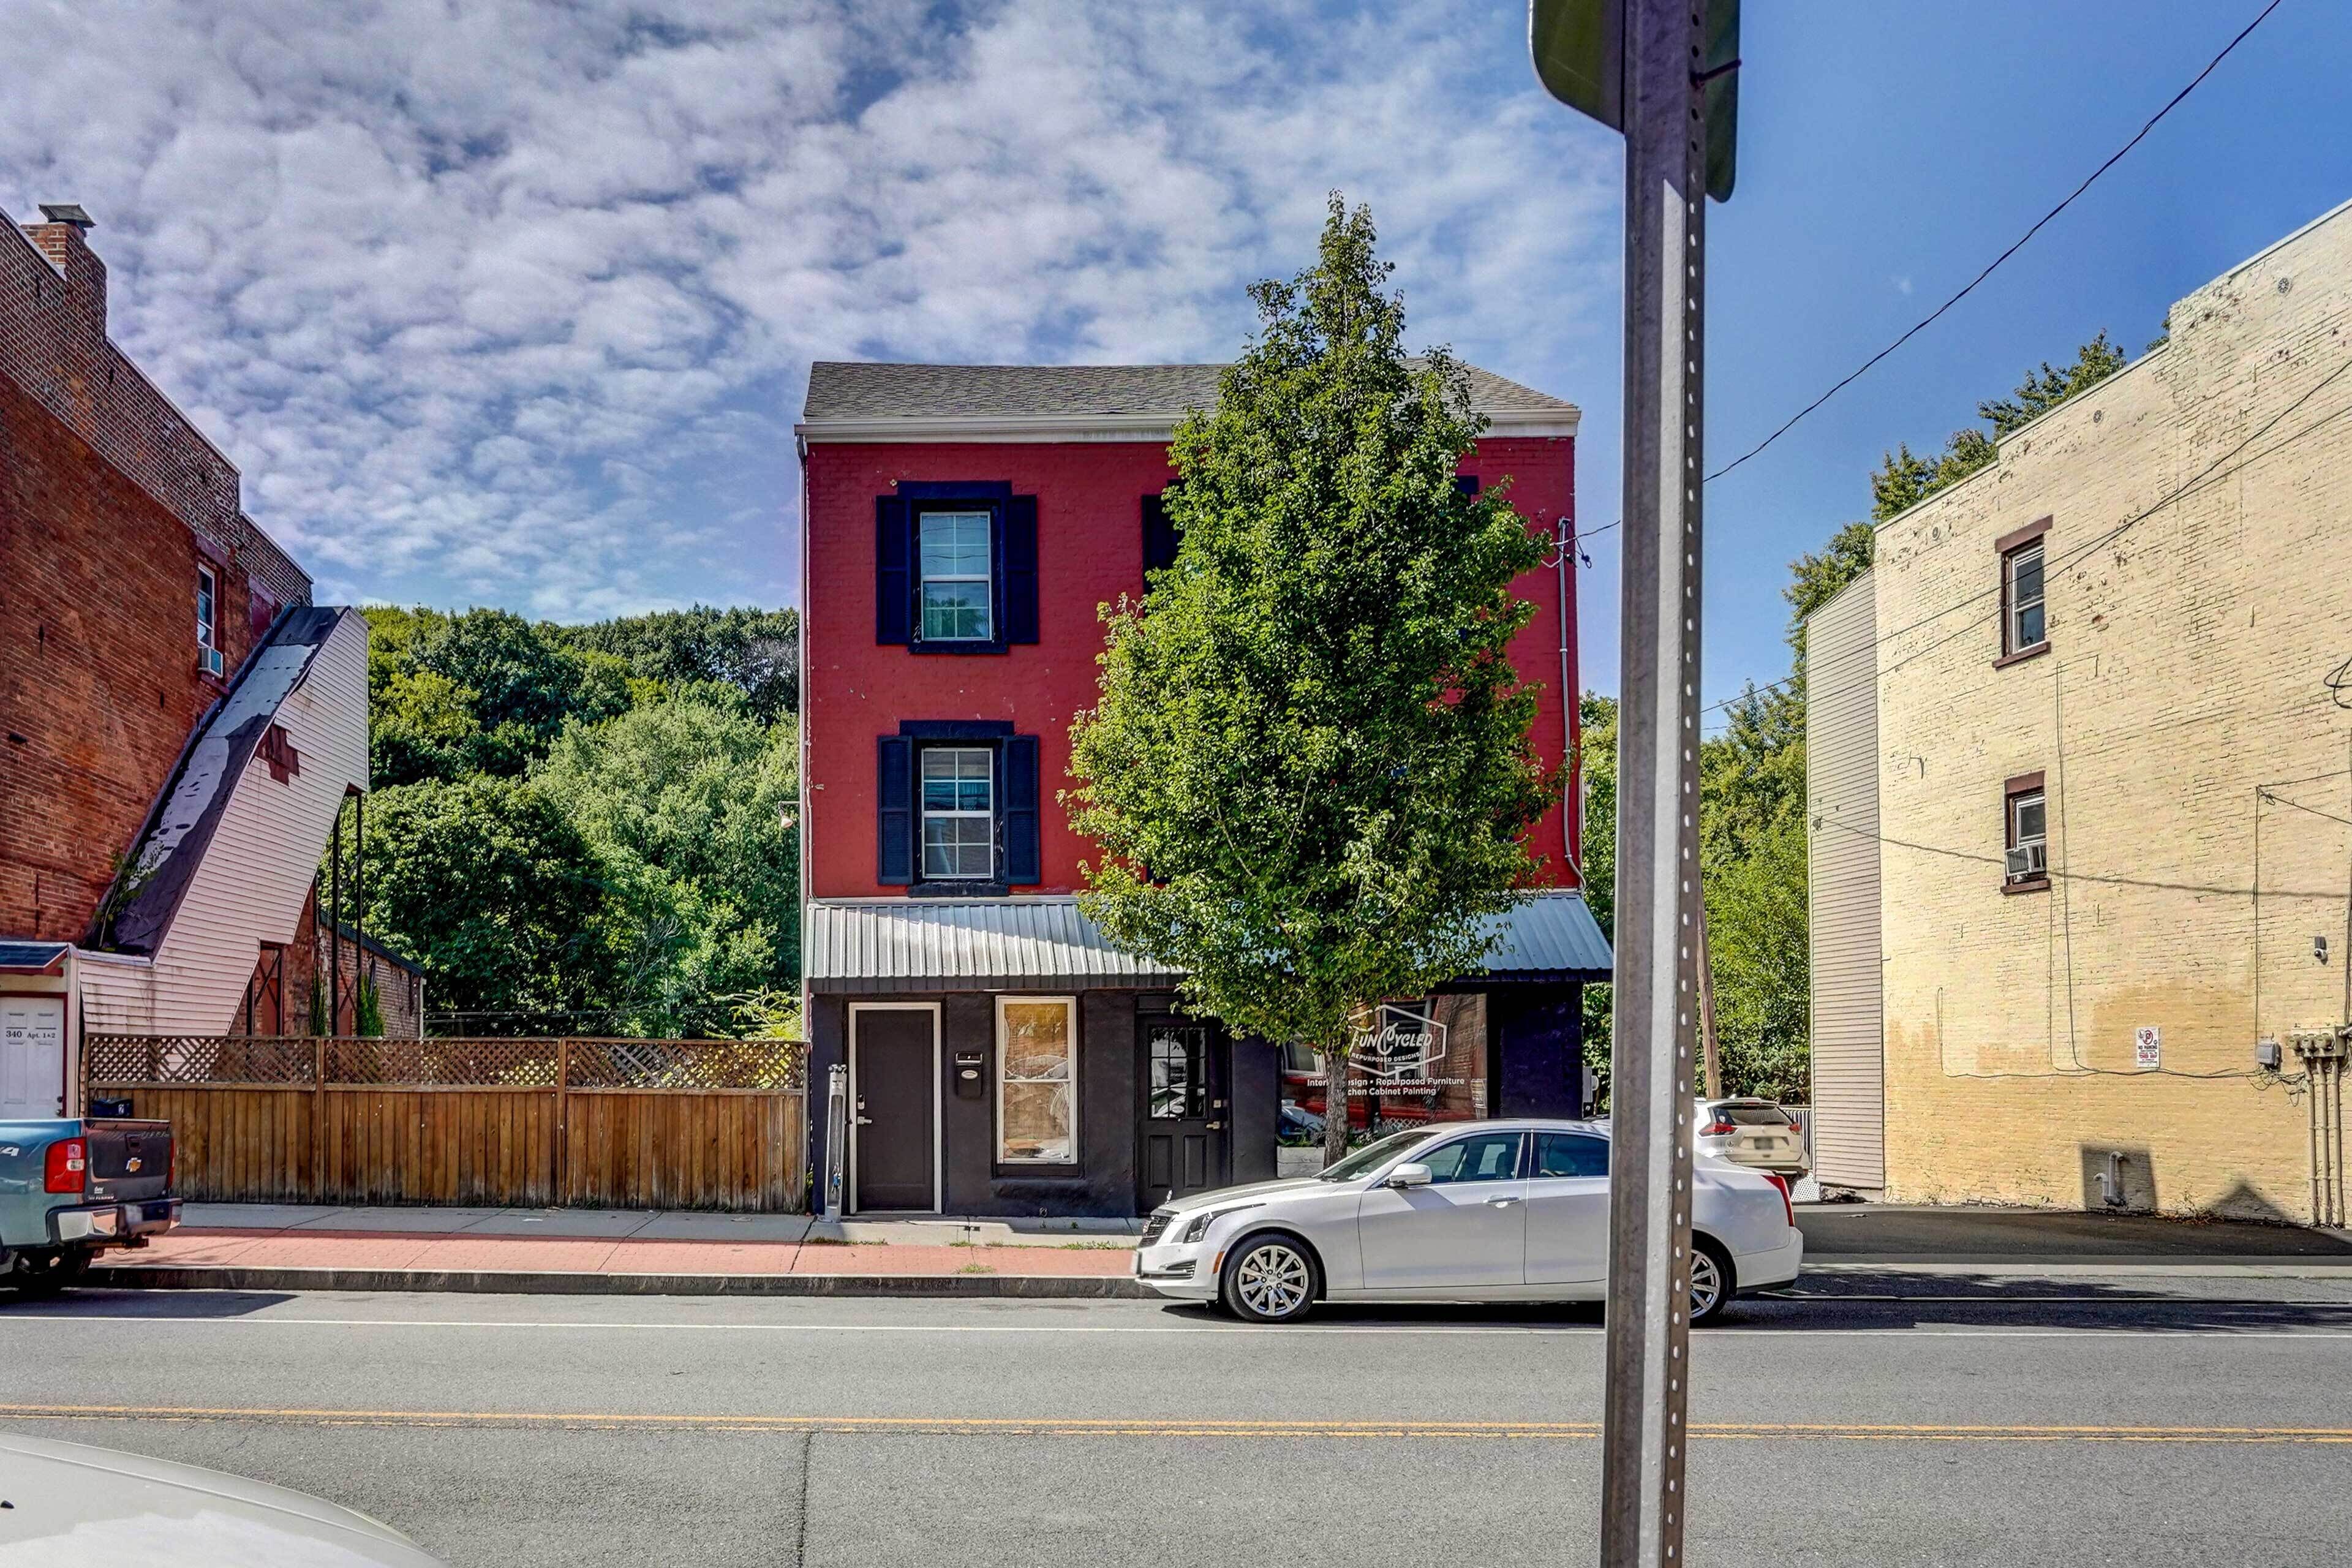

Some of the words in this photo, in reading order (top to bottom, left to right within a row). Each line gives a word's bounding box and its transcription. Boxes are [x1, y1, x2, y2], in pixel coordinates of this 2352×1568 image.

[1351, 1052, 1393, 1063] REPURPOSED
[1393, 1052, 1421, 1062] DESIGNS
[1376, 1077, 1425, 1087] Repurposed
[1369, 1087, 1401, 1096] Cabinet
[1403, 1087, 1437, 1096] Painting
